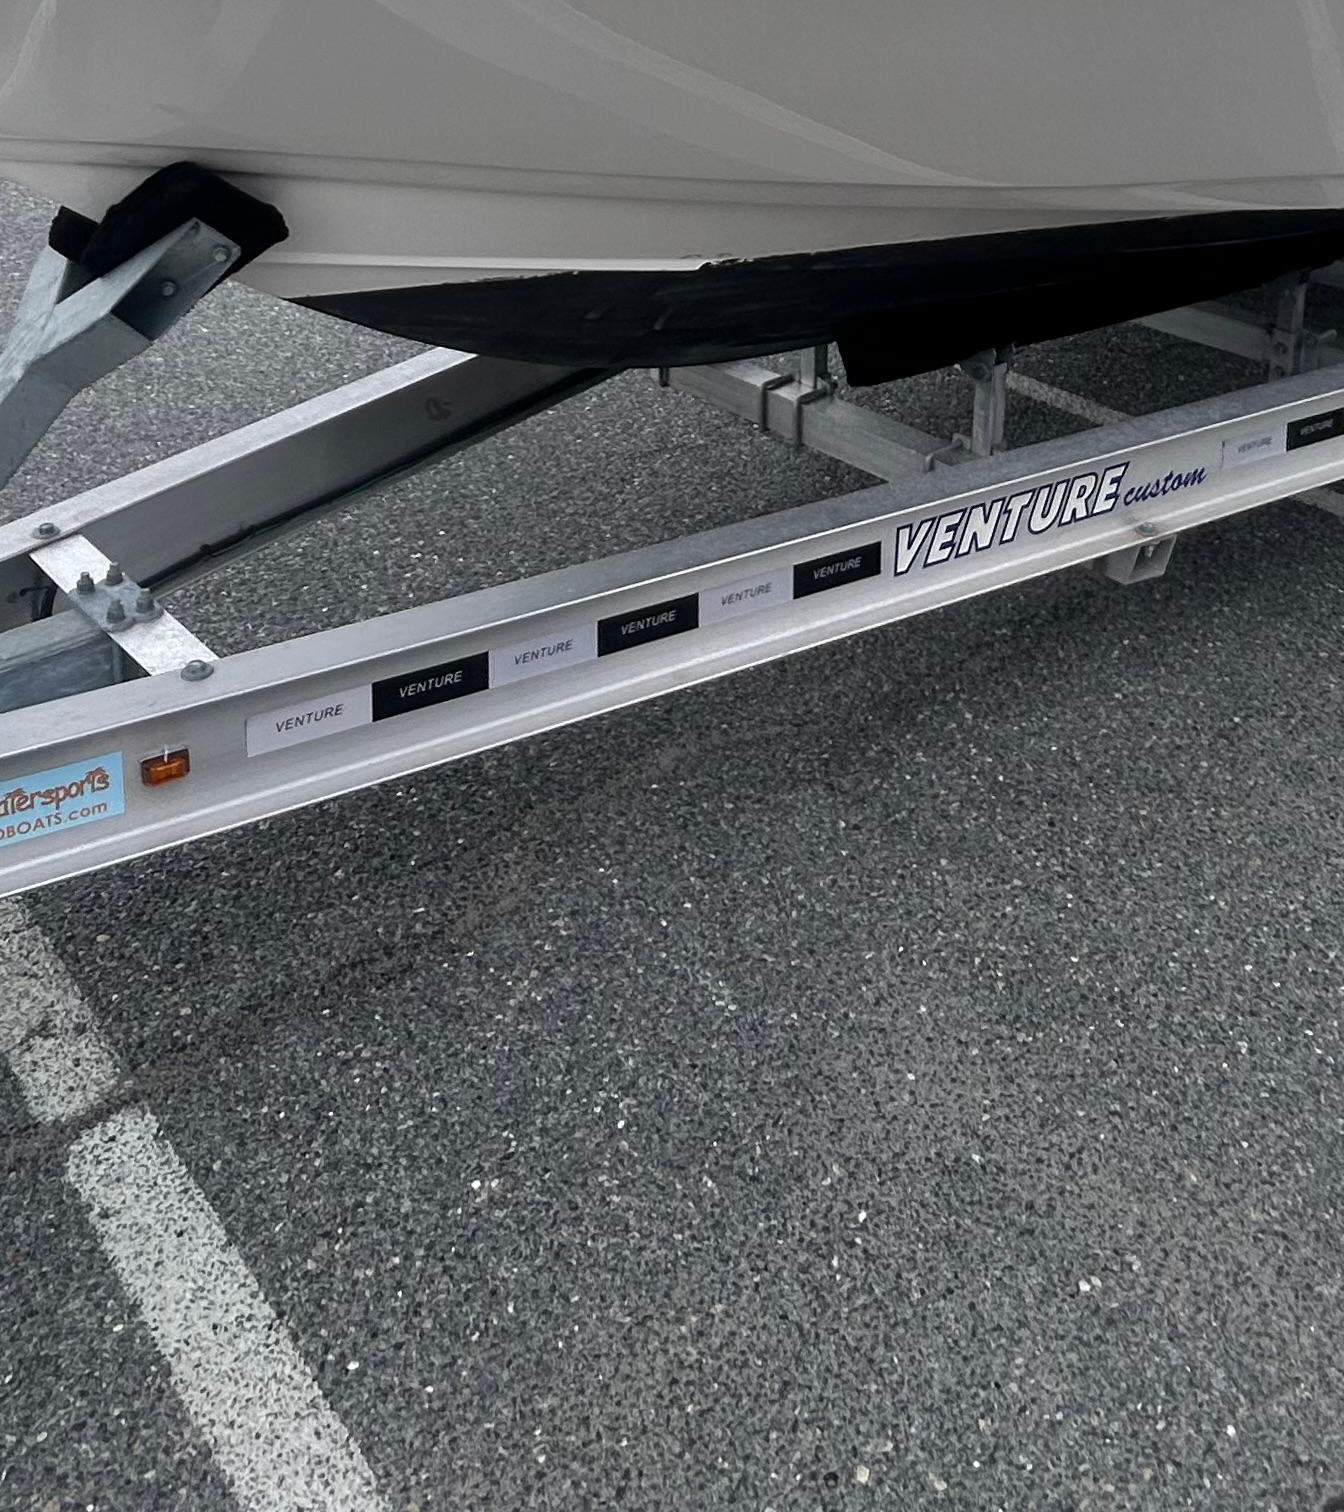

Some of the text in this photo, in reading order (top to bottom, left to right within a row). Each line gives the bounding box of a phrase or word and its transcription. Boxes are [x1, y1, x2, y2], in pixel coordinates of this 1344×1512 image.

[894, 461, 1206, 576] VENTURE custom
[812, 555, 862, 581] VENTURE
[720, 581, 773, 607] VENTURE
[620, 609, 678, 636] VENTURE
[513, 639, 574, 666] VENTURE
[398, 669, 463, 699] VENTURE
[274, 703, 345, 734] VENTURE
